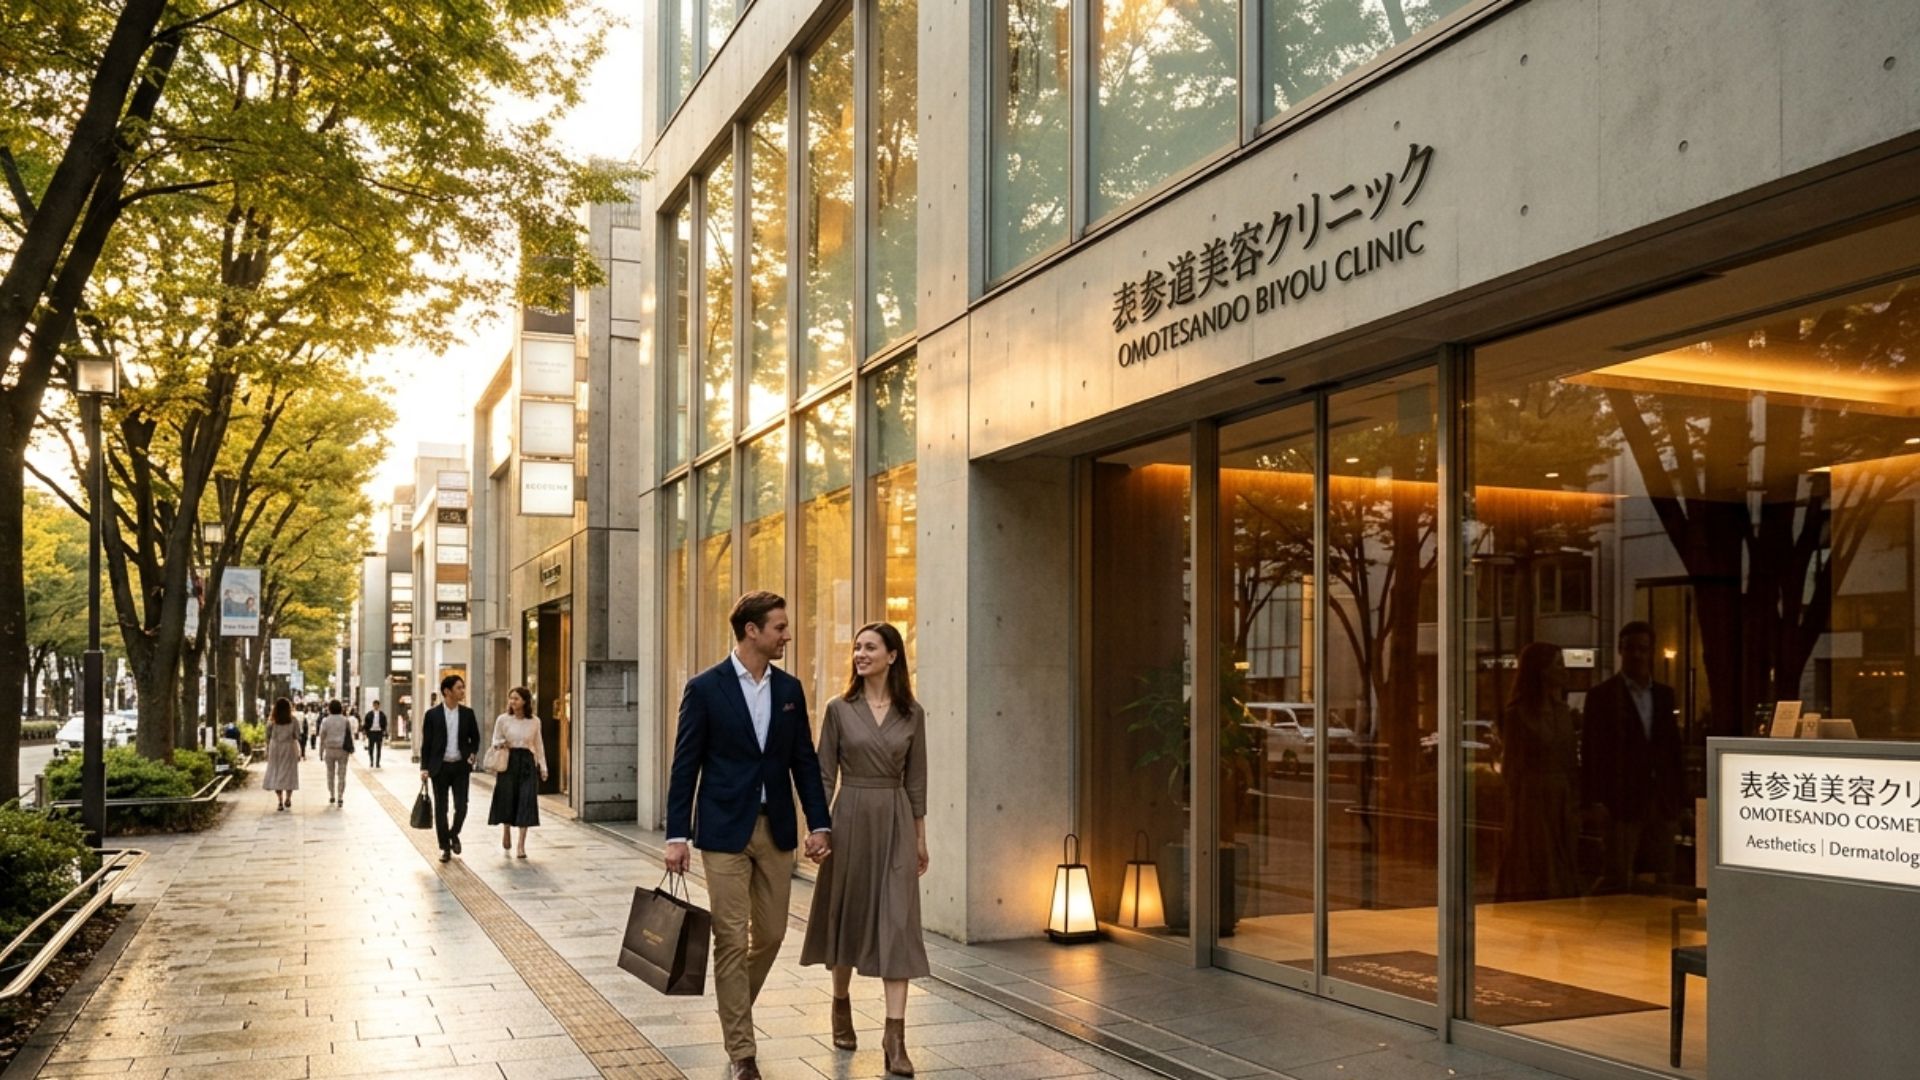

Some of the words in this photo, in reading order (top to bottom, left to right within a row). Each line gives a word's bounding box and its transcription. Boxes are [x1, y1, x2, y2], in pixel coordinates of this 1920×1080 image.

[1118, 294, 1251, 367] OMOTESANDO
[1255, 260, 1328, 315] BIYOU
[1335, 220, 1425, 282] CLINIC
[1739, 806, 1850, 827] OMOTESANDO
[1746, 834, 1816, 854] Aesthetics
[1829, 841, 1920, 869] Dermatolog
